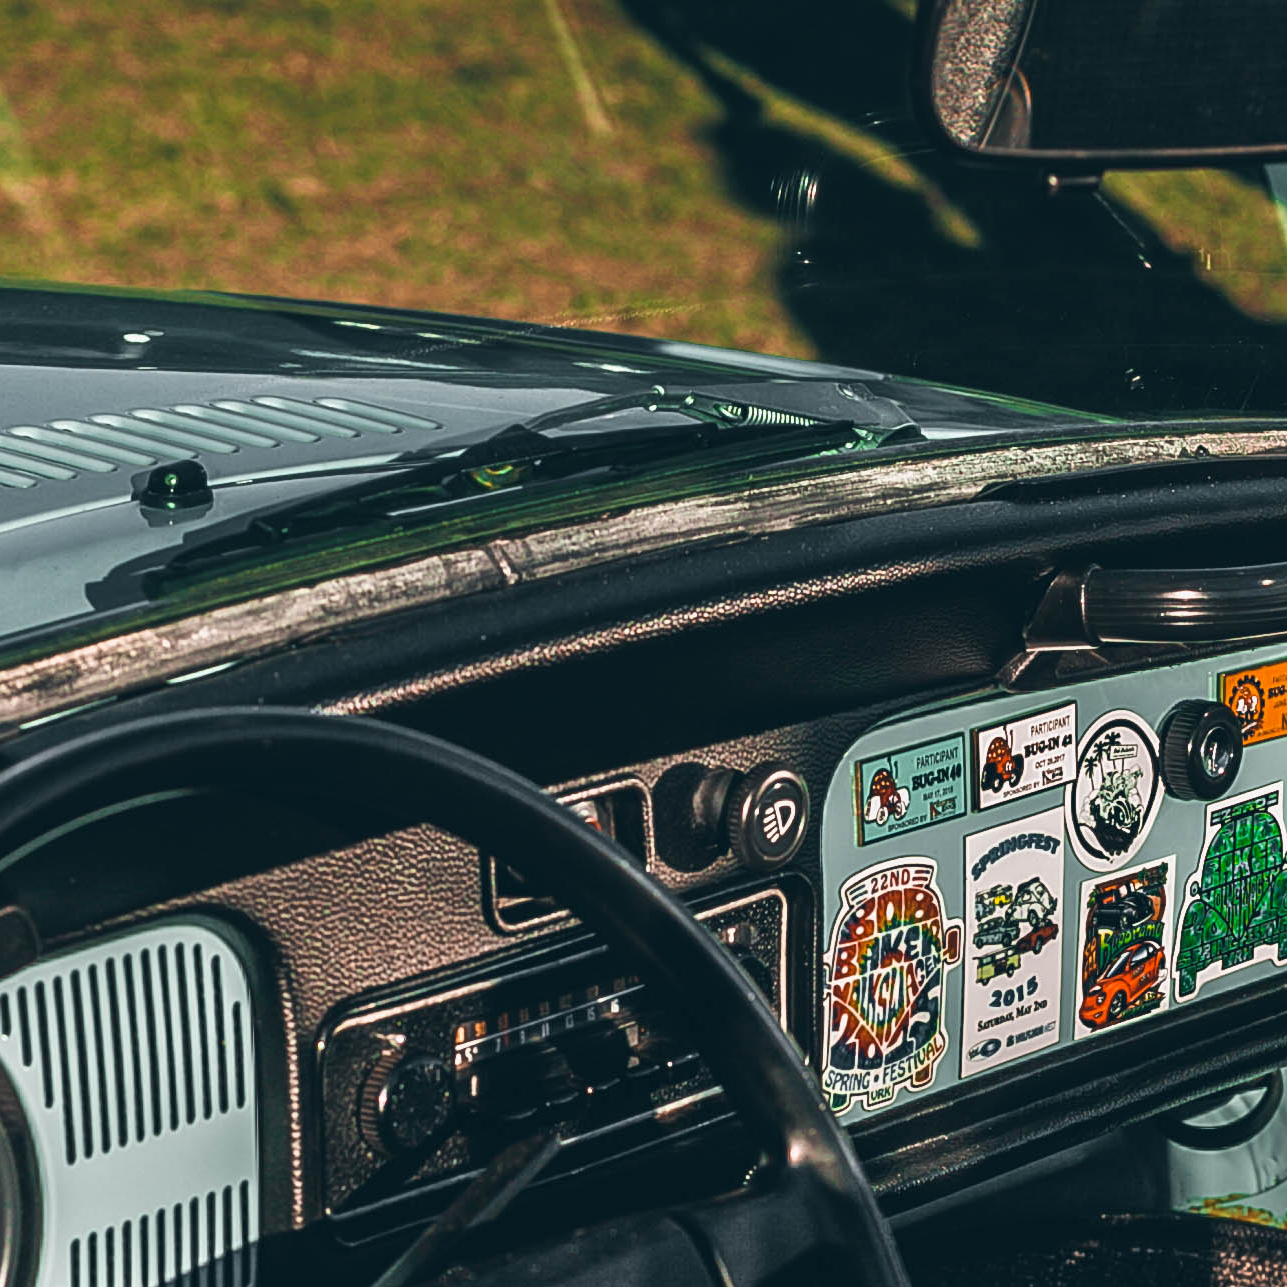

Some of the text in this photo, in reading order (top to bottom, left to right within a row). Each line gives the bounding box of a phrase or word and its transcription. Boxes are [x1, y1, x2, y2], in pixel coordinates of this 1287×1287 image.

[1031, 715, 1070, 736] PARTICIPANT
[916, 746, 959, 769] PARTICIPANT
[1024, 736, 1060, 758] BUG-IN
[912, 766, 950, 791] BUG-IN
[1003, 784, 1032, 798] SPONSORED
[888, 817, 919, 832] SPONSORED
[971, 833, 1060, 881] SPRINGFEST
[871, 868, 911, 894] 22ND
[838, 888, 939, 944] BOB
[834, 919, 942, 980] BAKER
[989, 976, 1038, 1007] 2015
[825, 1037, 943, 1091] SPRING FESTIVAL
